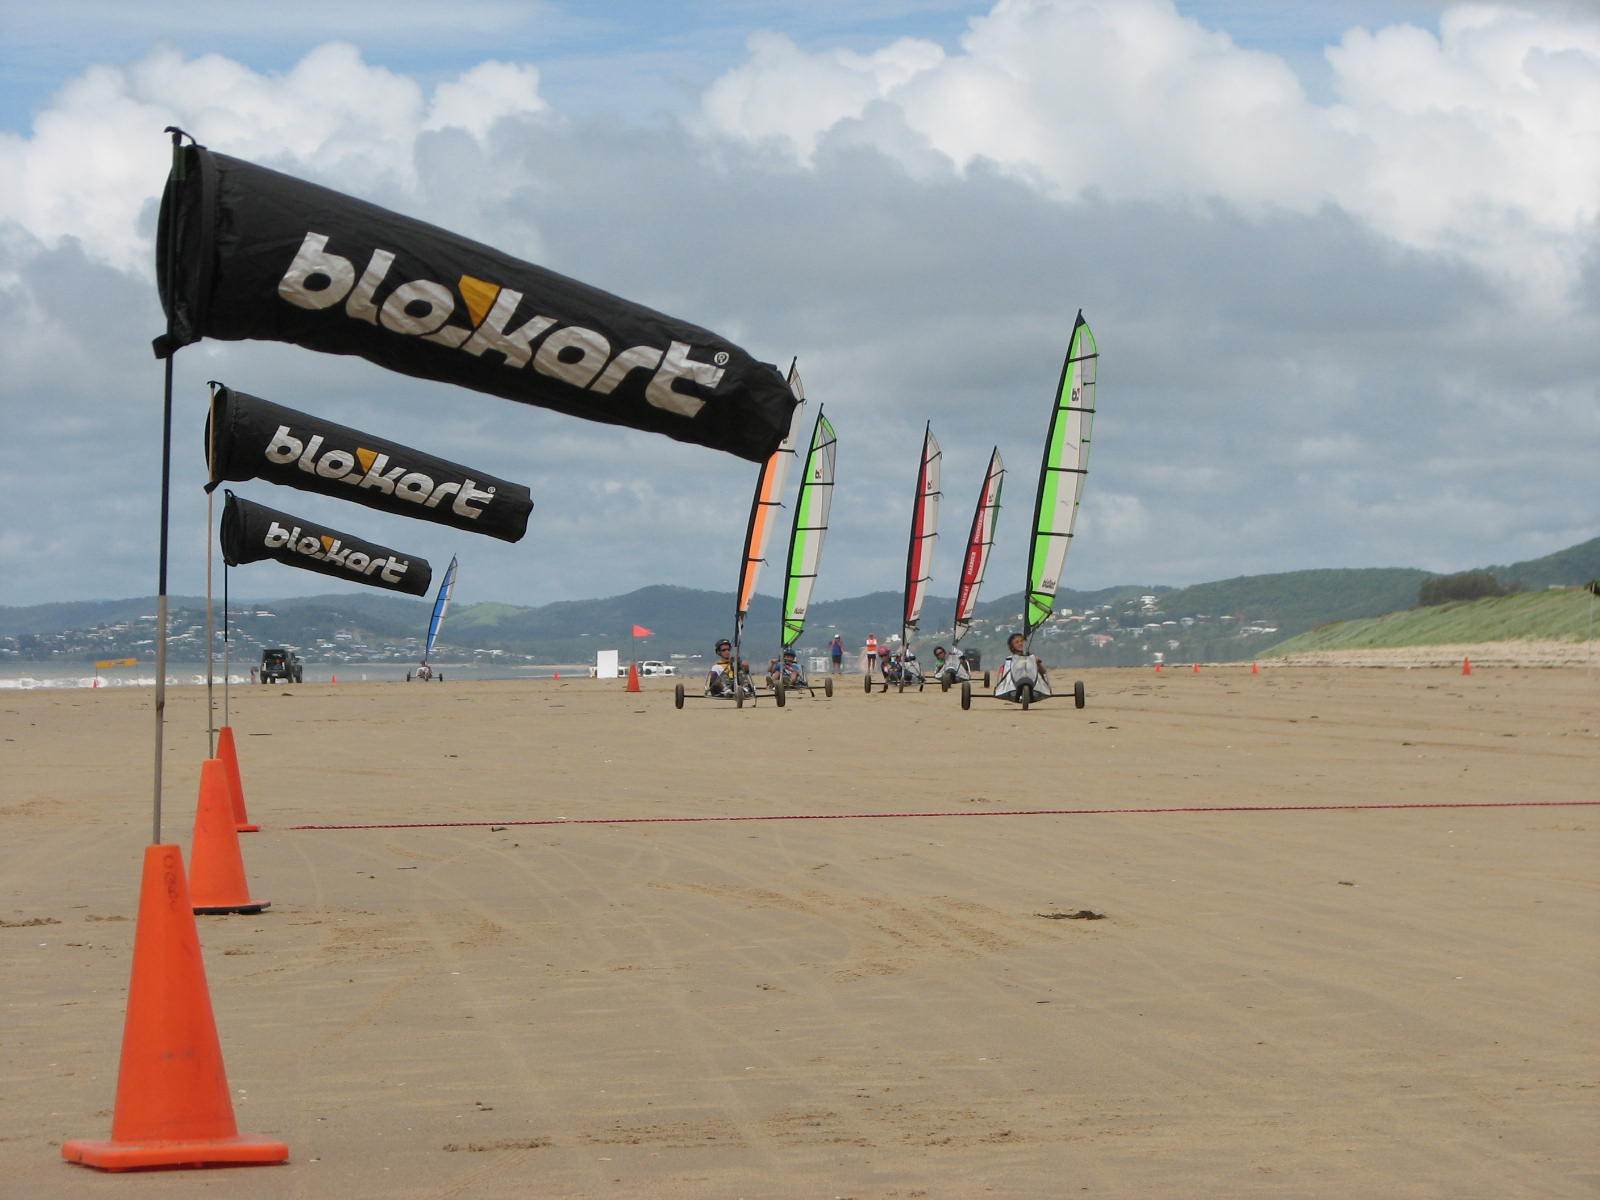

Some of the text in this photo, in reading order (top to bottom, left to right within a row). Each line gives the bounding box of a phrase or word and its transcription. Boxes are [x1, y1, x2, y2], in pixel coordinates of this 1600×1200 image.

[278, 231, 729, 418] blokart
[264, 425, 495, 520] blokart
[264, 522, 409, 584] blokart
